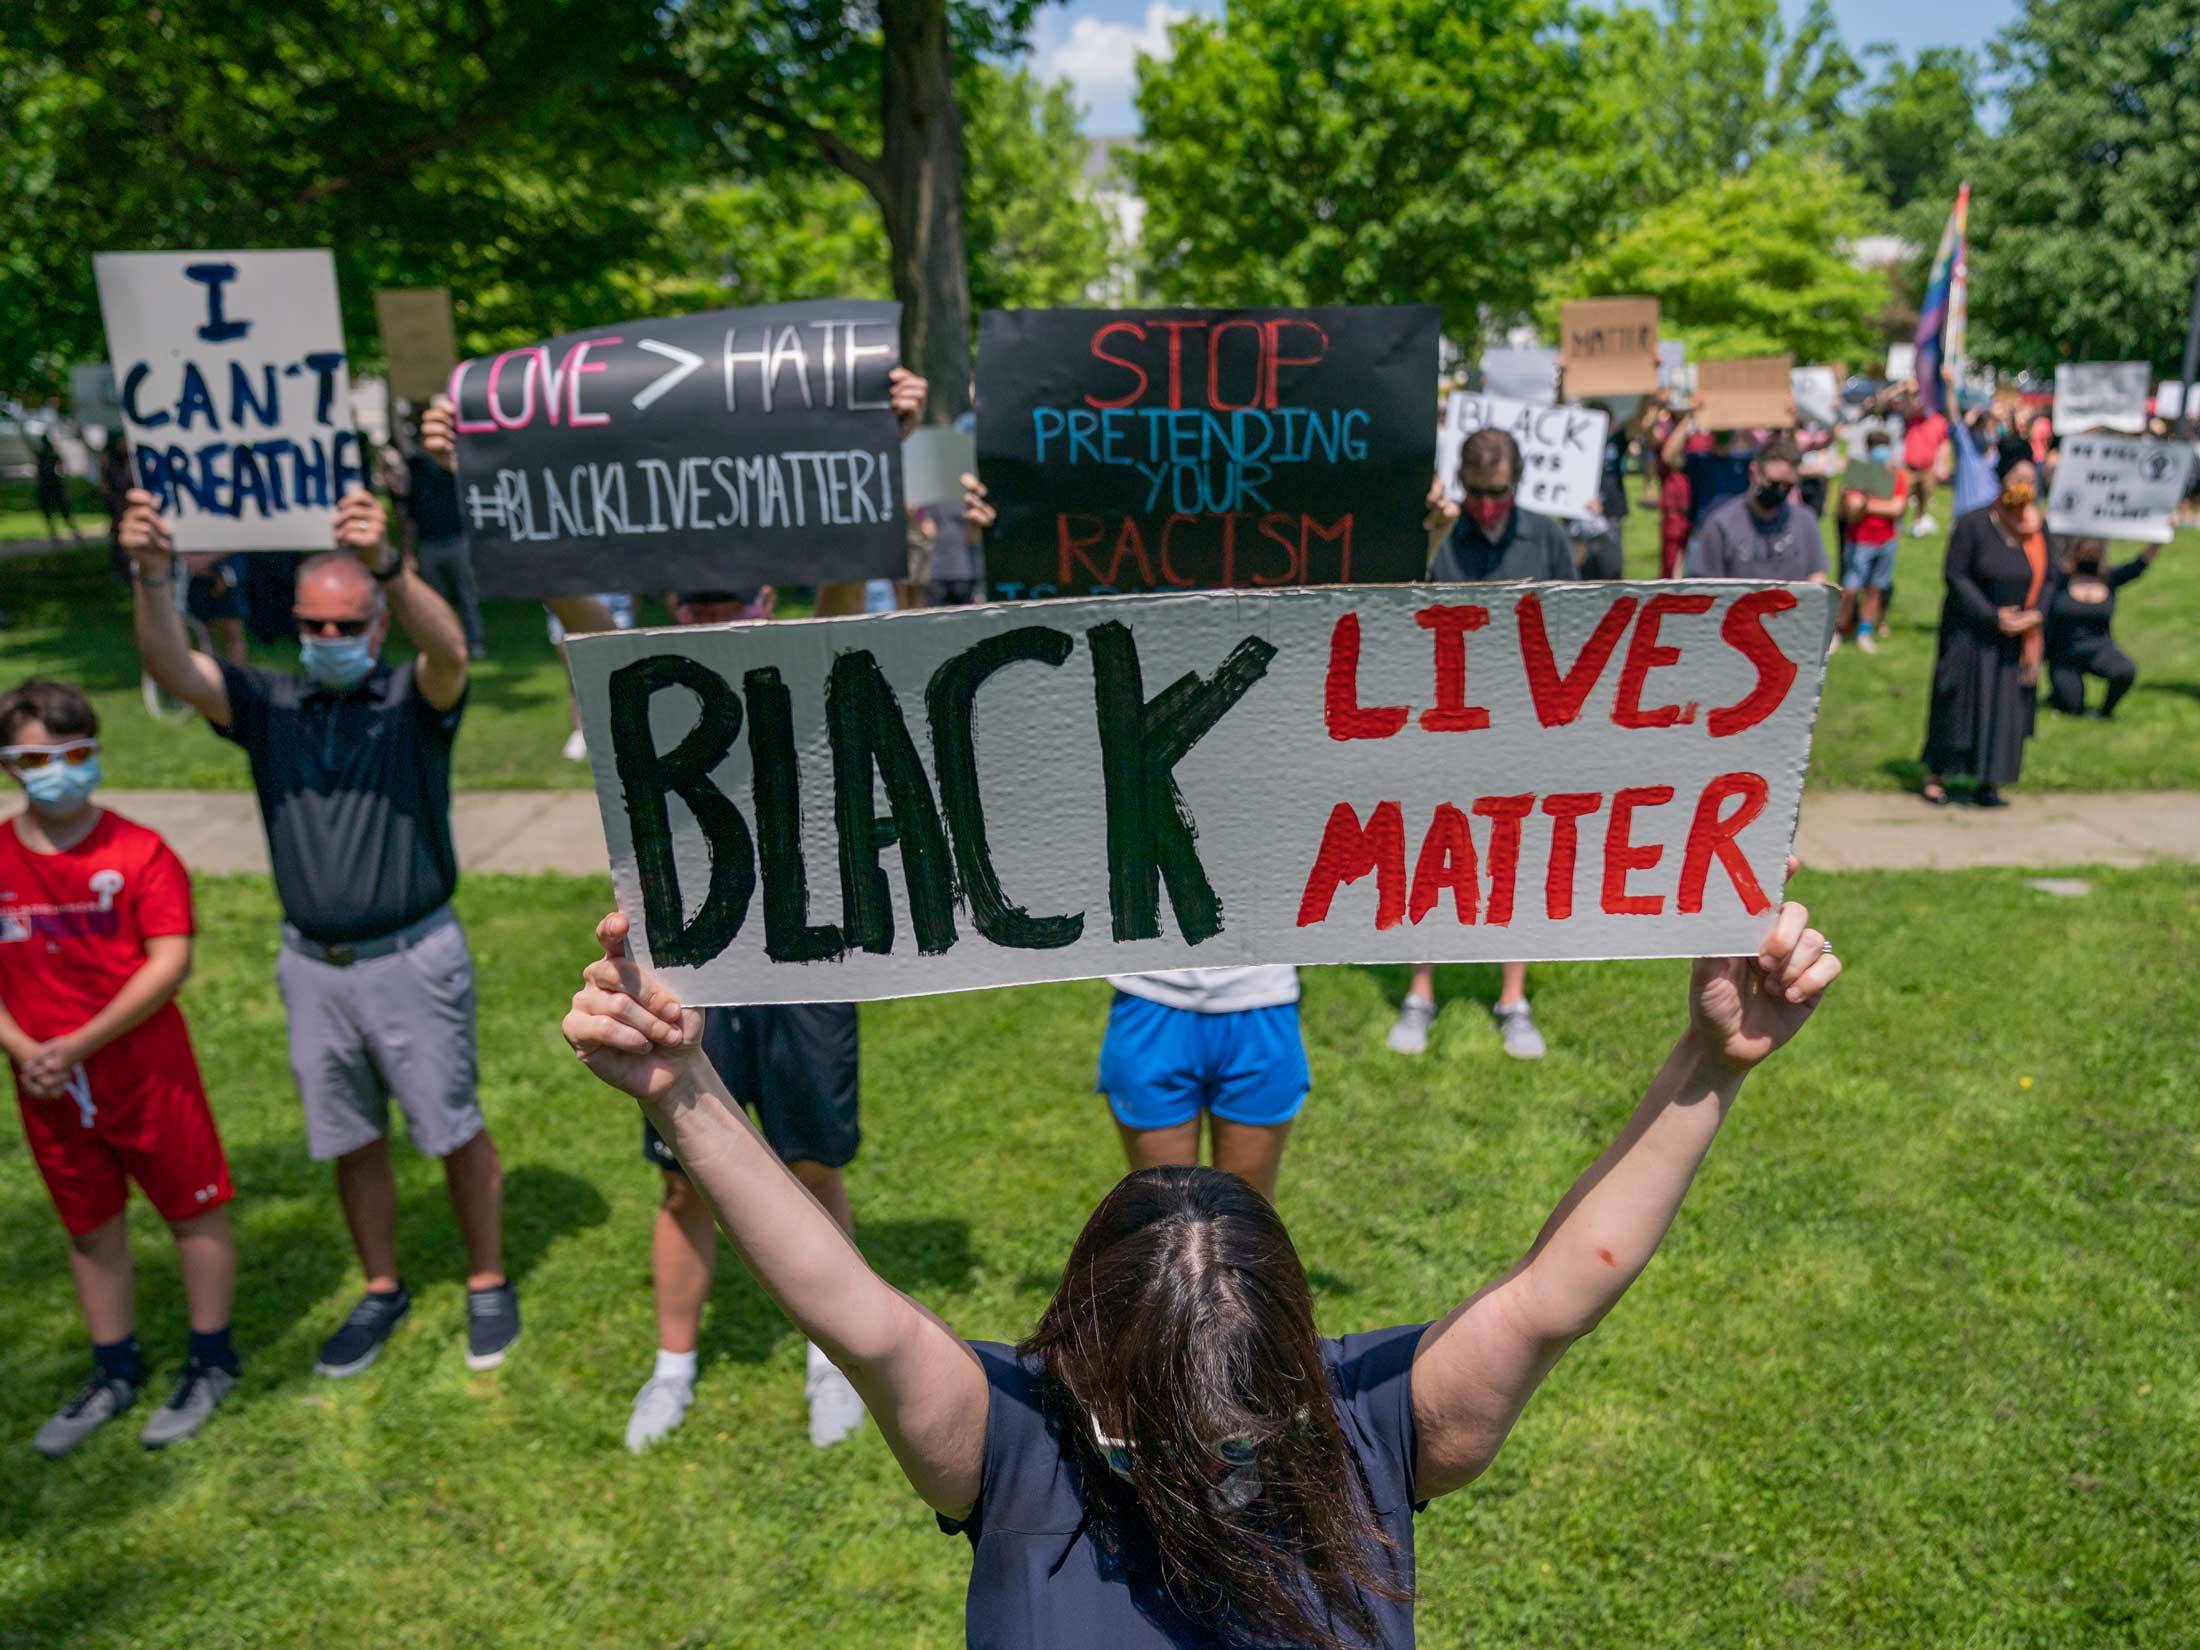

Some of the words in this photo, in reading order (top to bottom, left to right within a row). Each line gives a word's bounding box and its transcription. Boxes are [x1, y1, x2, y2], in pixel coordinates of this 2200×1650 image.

[184, 262, 252, 342] I
[122, 352, 345, 432] CAN'T
[449, 337, 624, 433] LOVE
[723, 320, 891, 412] HATE
[1084, 319, 1330, 411] STOP
[1032, 406, 1370, 465] PRETENDING
[466, 449, 894, 542] #BLACKLIVESMATTER!
[1134, 461, 1273, 515] YOUR
[1055, 511, 1354, 586] RACISM
[609, 620, 1278, 969] BLACK
[1324, 588, 1798, 741] LIVES
[1296, 771, 1772, 931] MATTER
